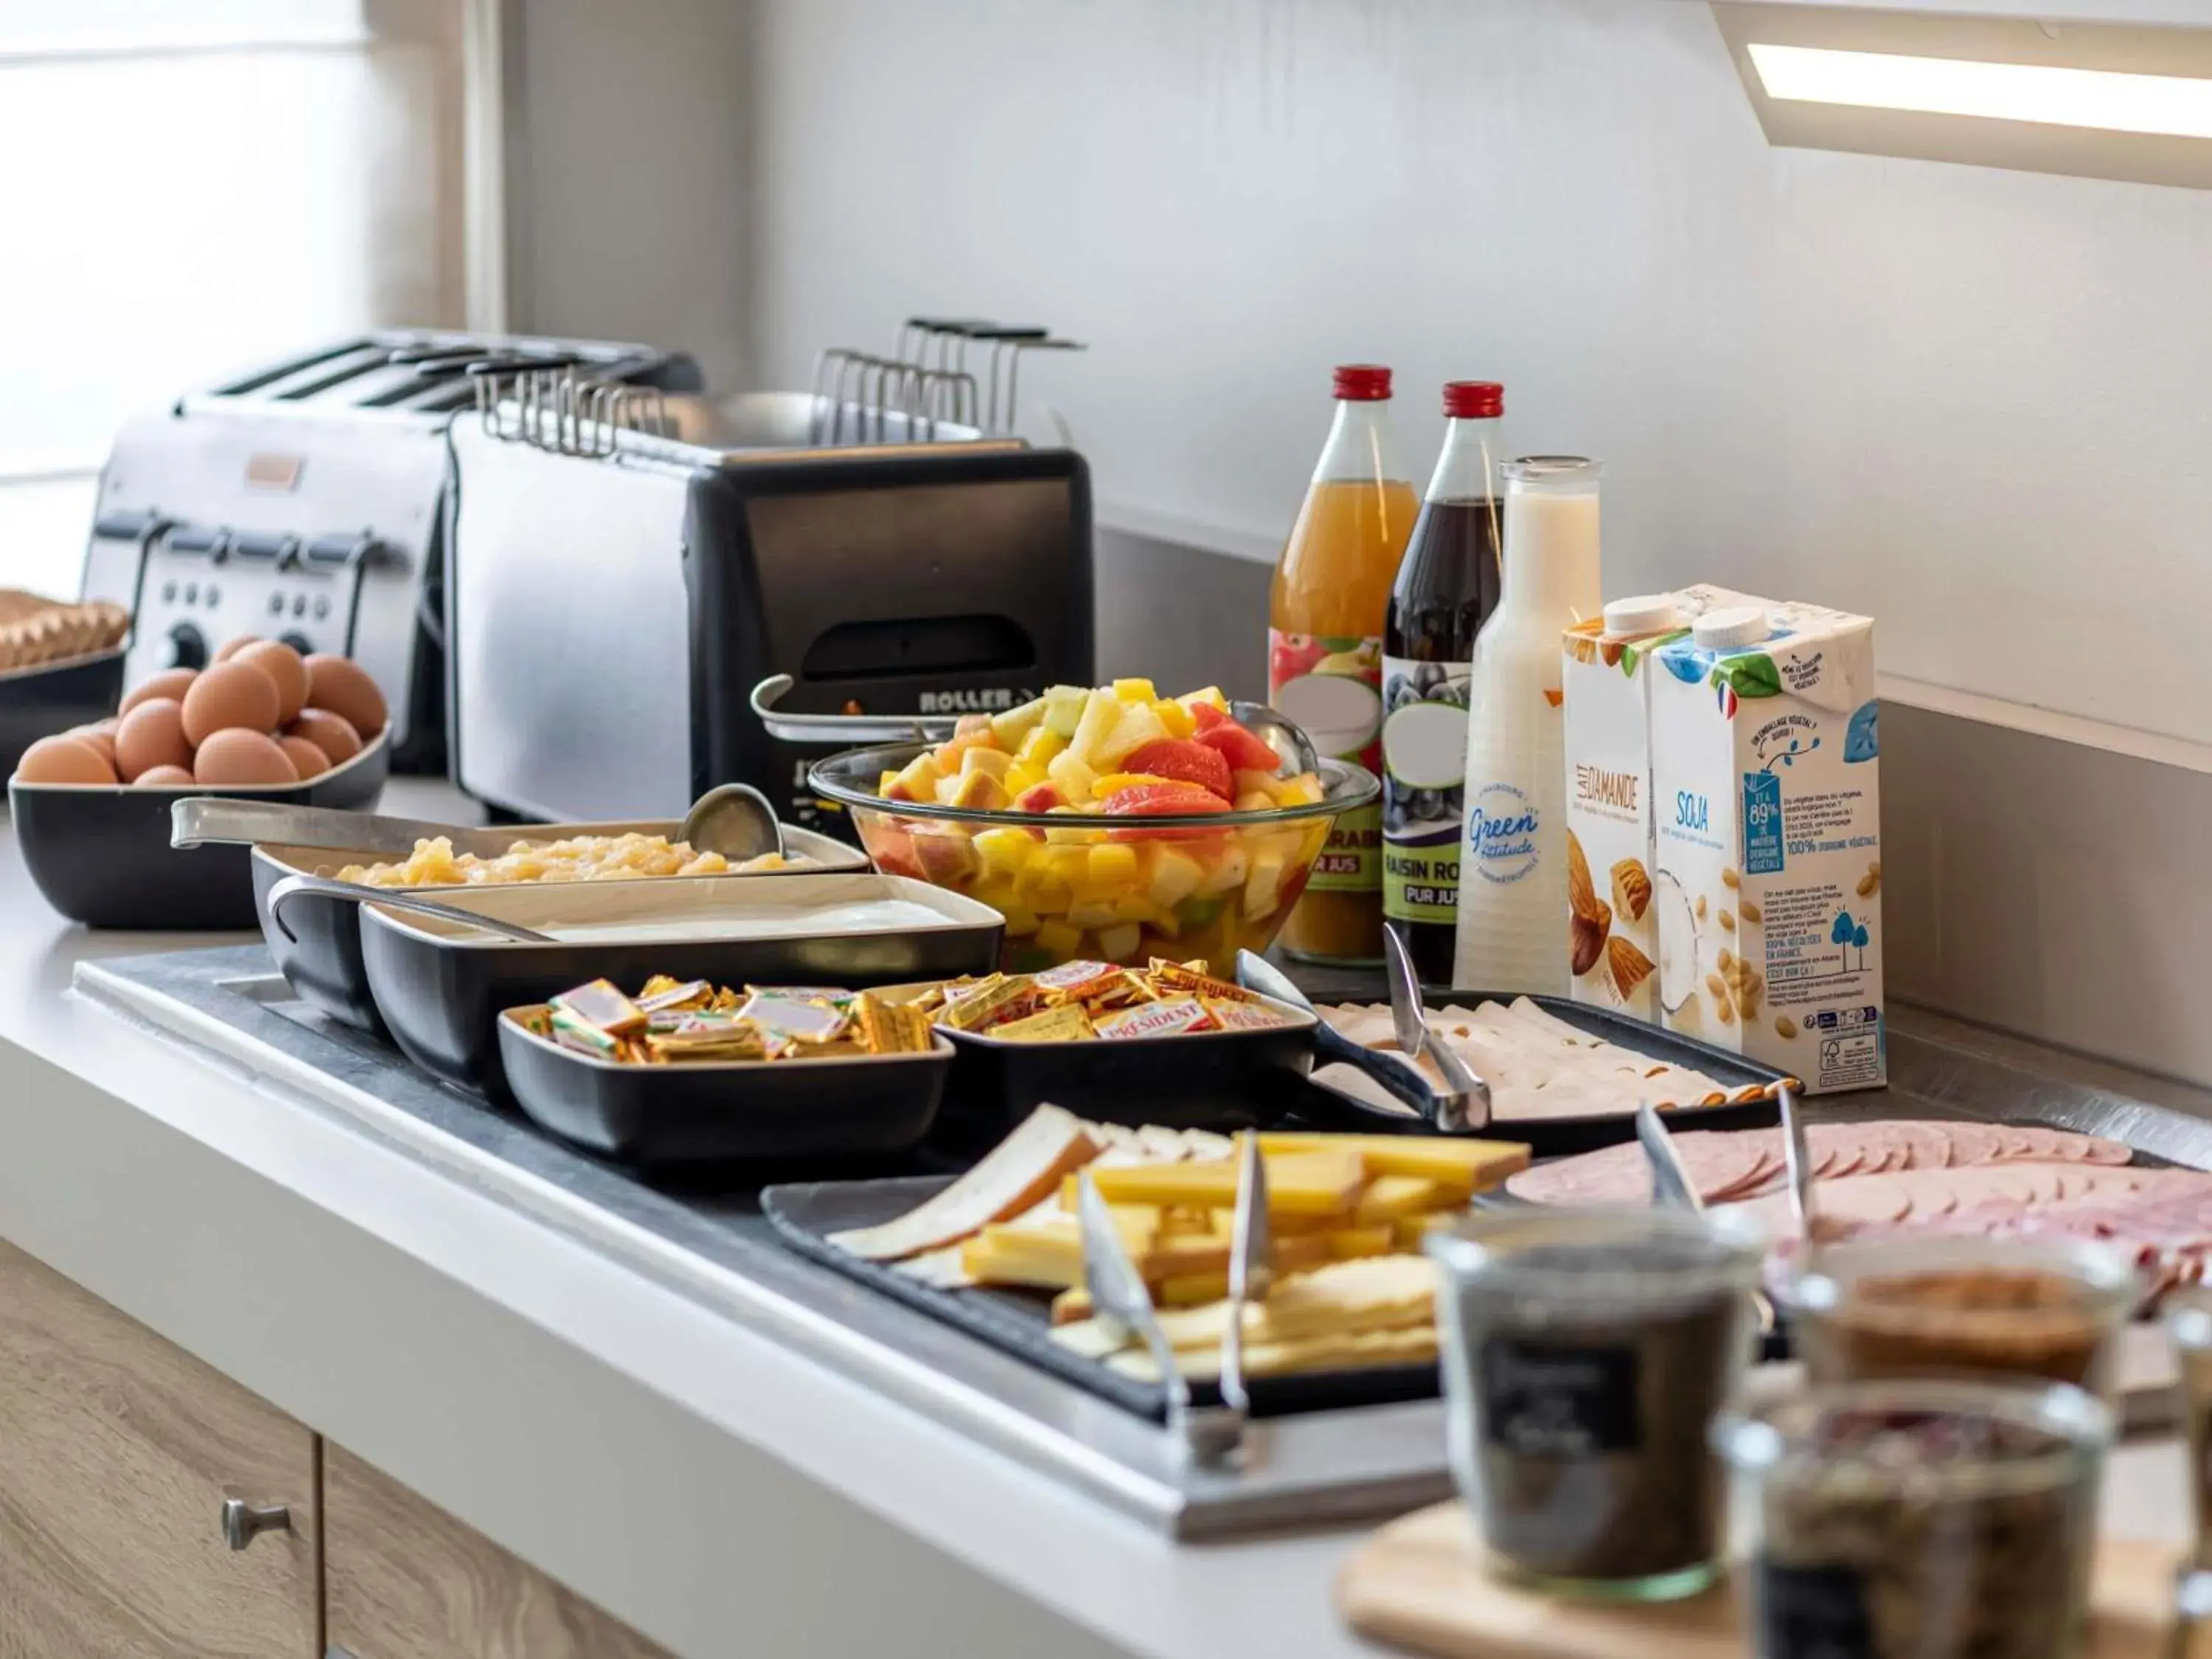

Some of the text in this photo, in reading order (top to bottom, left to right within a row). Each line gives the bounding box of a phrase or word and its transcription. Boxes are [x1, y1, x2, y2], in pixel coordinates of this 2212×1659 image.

[919, 689, 1013, 714] ROLLER
[1576, 764, 1588, 799] LAIT
[1676, 790, 1708, 833] SOJA
[1750, 802, 1779, 826] 89%
[1470, 808, 1538, 853] Green
[1787, 838, 1816, 855] 100%
[1434, 861, 1460, 881] RO
[1406, 886, 1435, 902] PUR
[1108, 1003, 1199, 1038] PRÉSIDENT
